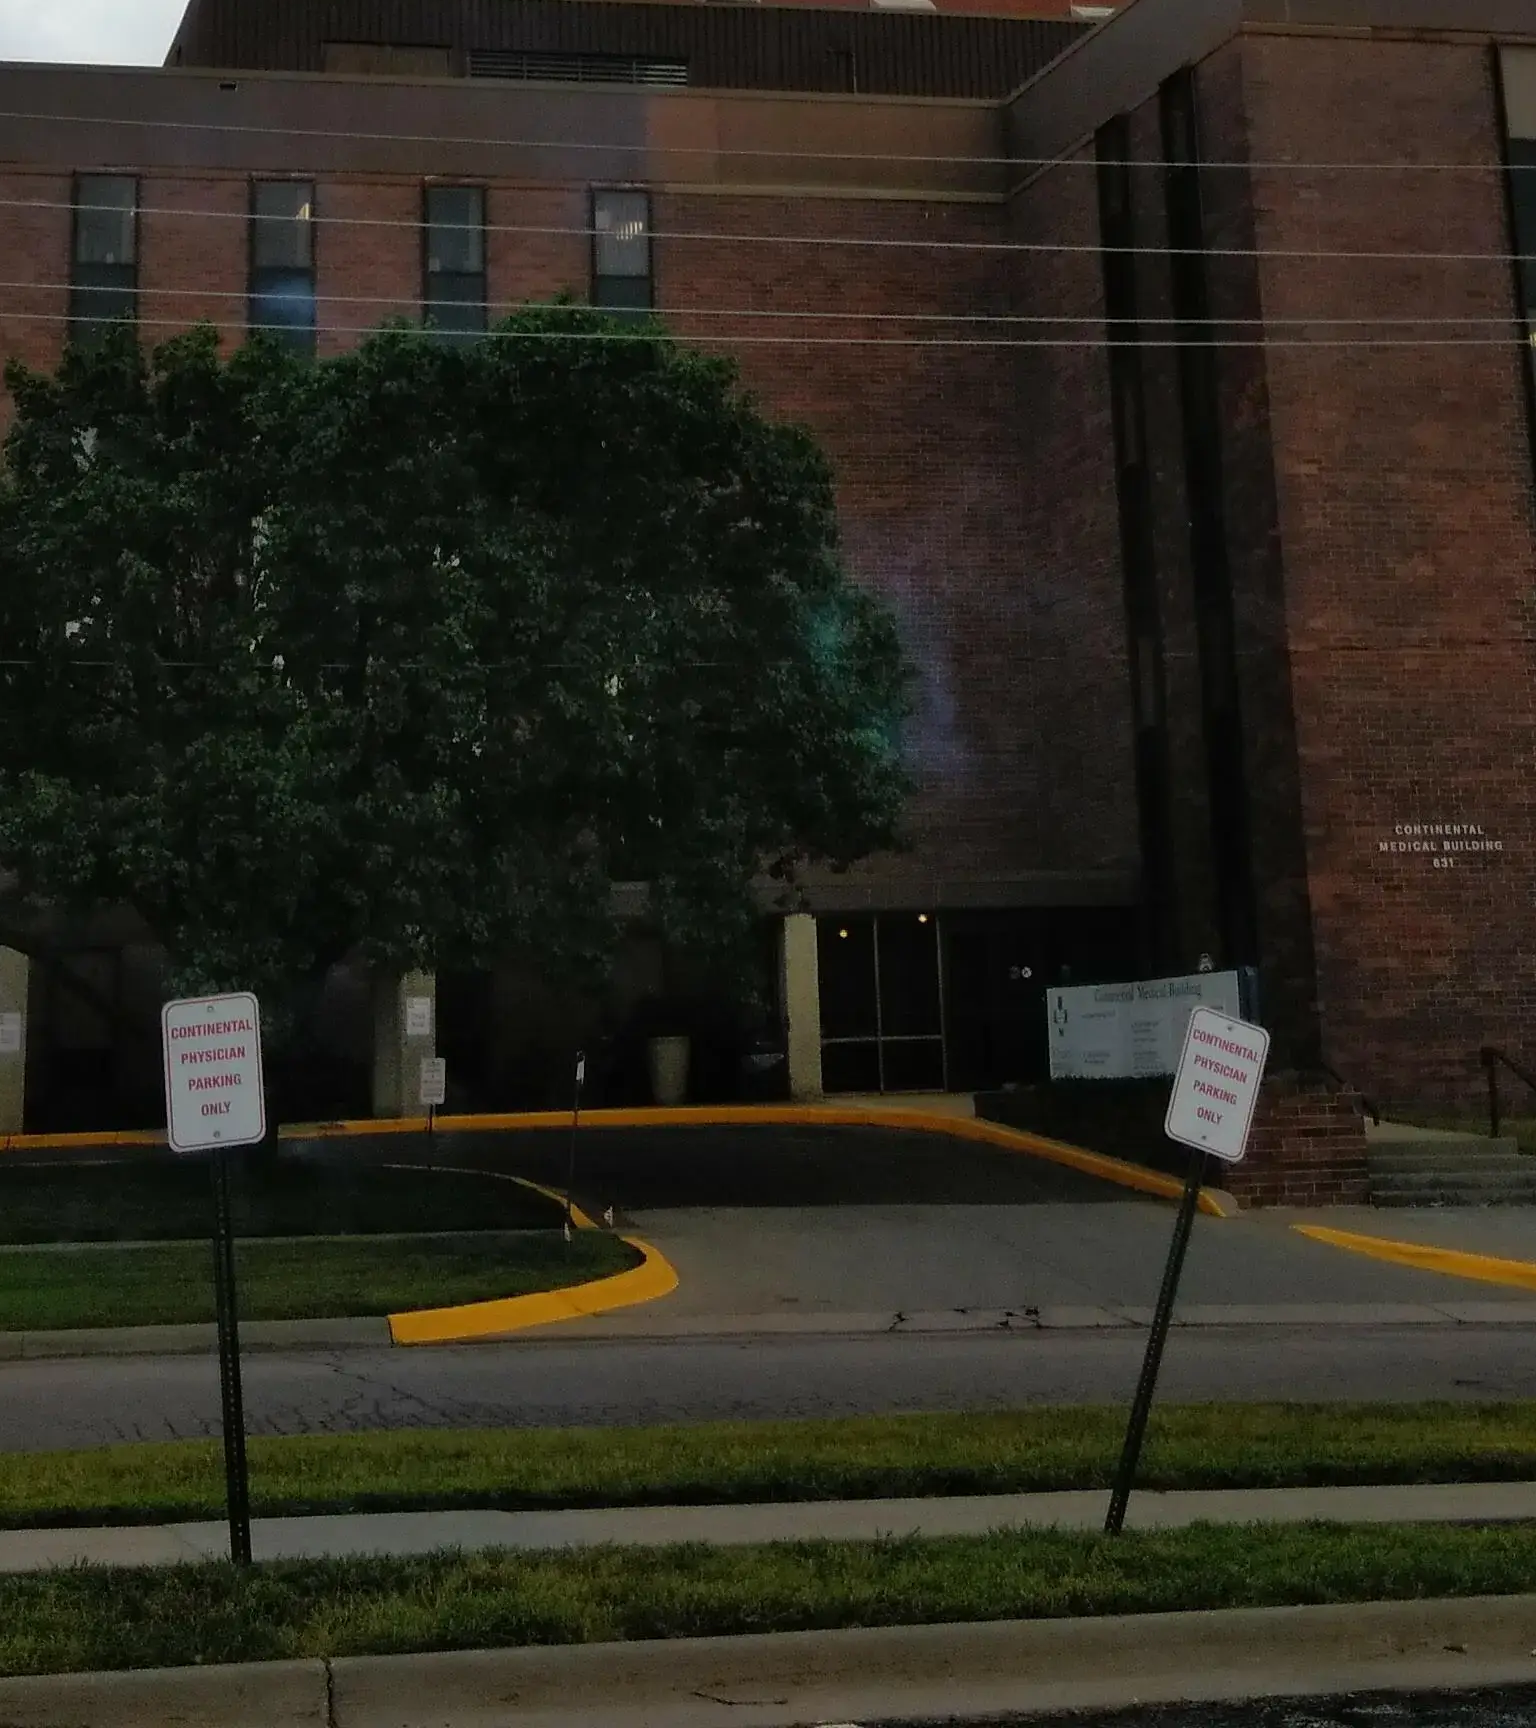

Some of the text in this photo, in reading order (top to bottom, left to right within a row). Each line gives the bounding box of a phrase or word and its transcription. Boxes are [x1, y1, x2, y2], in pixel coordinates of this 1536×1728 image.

[1395, 824, 1485, 835] CONTINENTAL
[1379, 840, 1504, 852] MEDICAL BUILDING
[1433, 858, 1455, 868] 631
[171, 1019, 253, 1040] CONTINENTAL
[1193, 1028, 1260, 1063] CONTINENTAL
[181, 1046, 246, 1064] PHYSICIAN
[1193, 1055, 1248, 1084] PHYSICIAN
[188, 1074, 242, 1091] PARKING
[1193, 1080, 1238, 1105] PARKING
[201, 1101, 231, 1116] ONLY
[1196, 1107, 1223, 1125] ONLY
